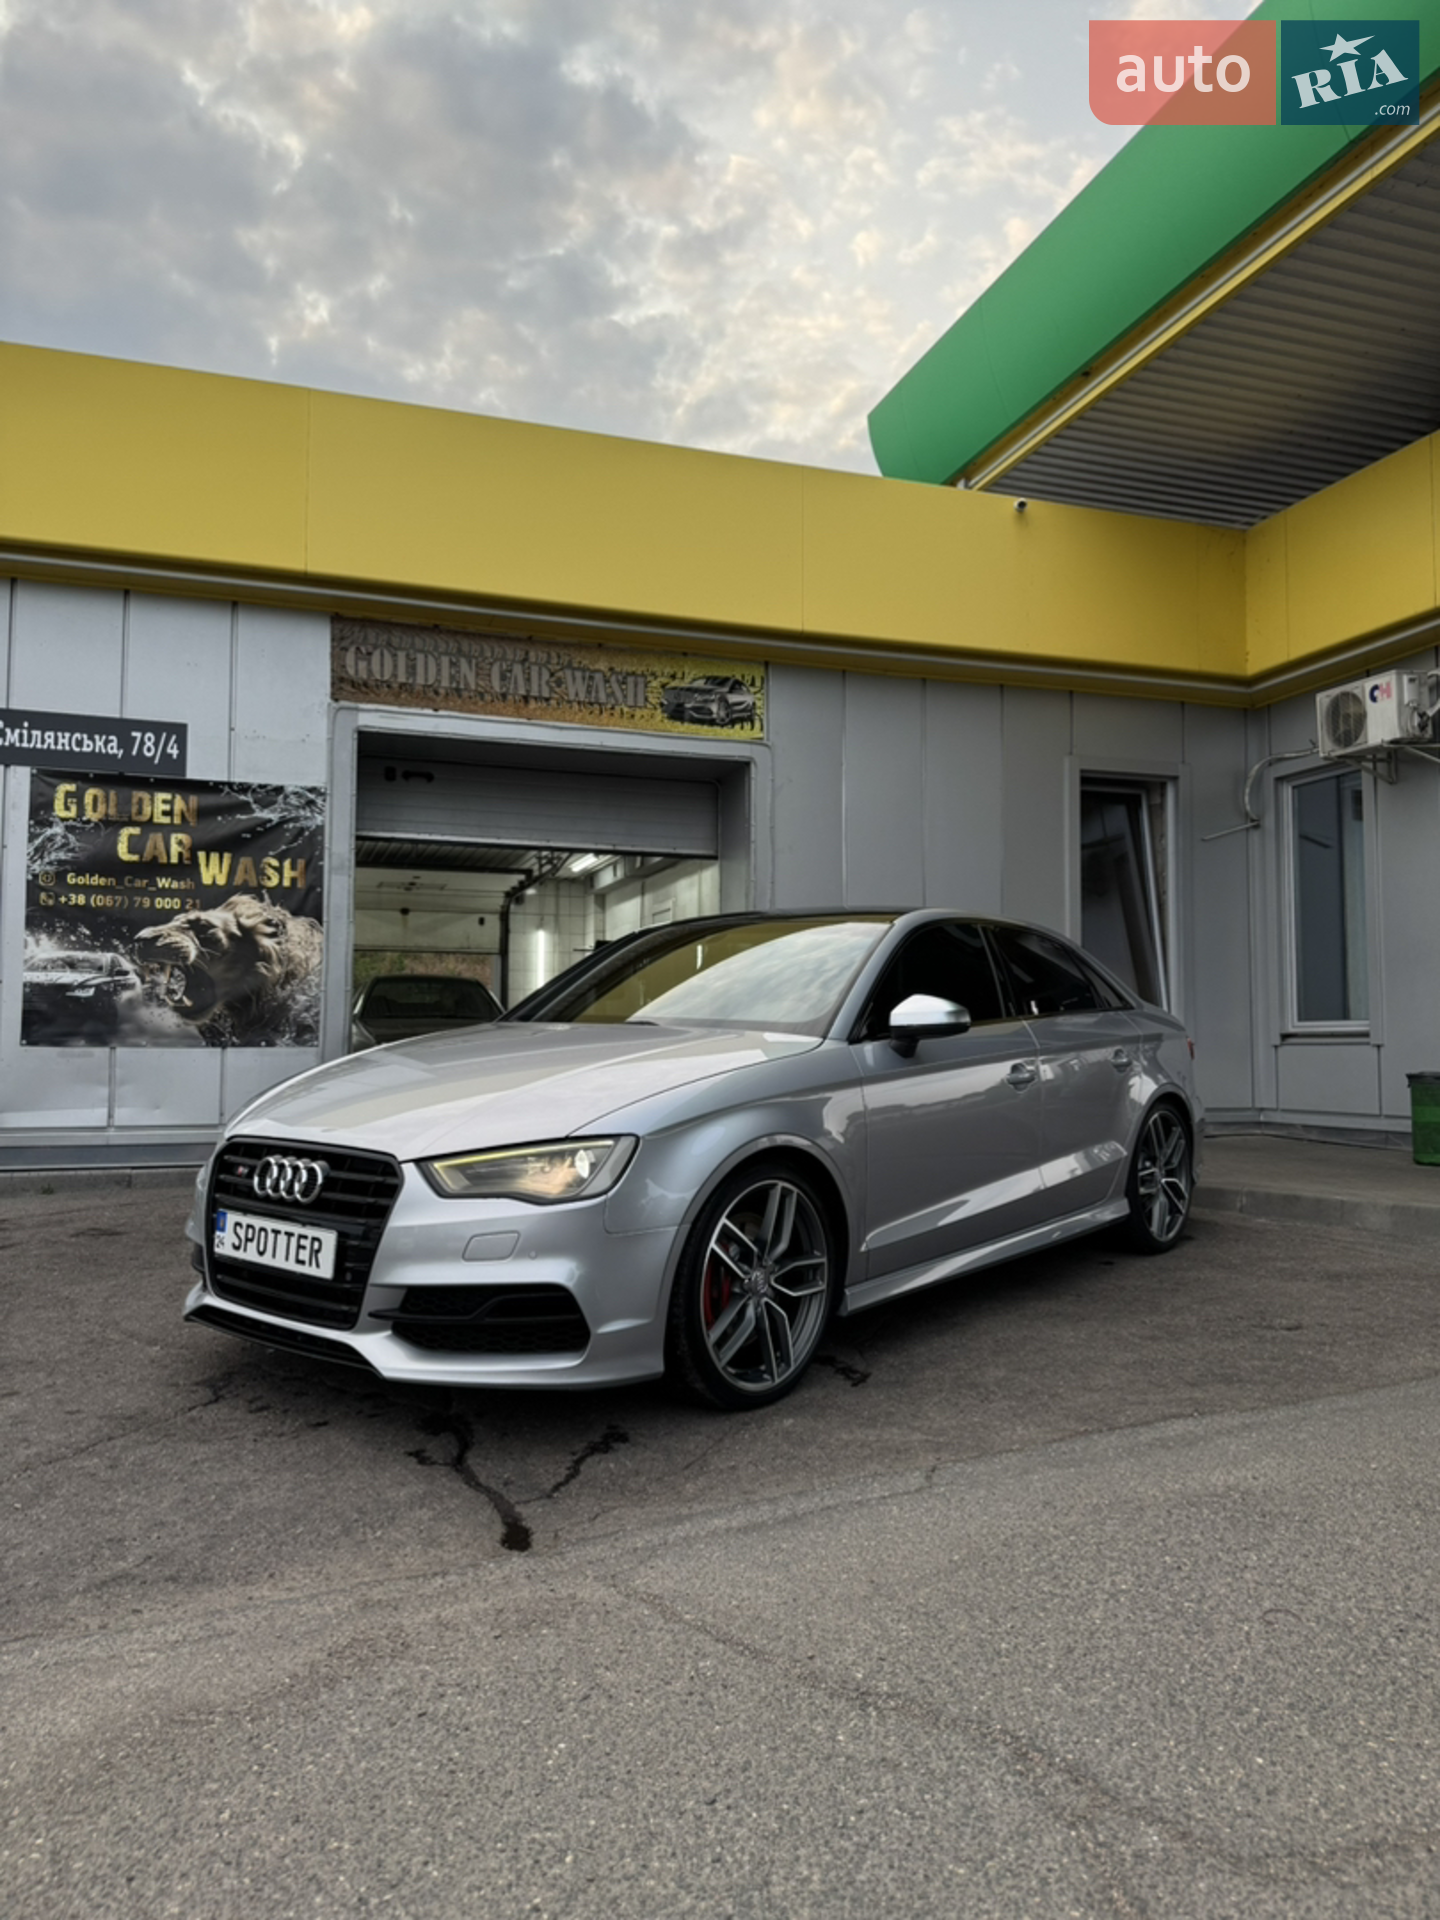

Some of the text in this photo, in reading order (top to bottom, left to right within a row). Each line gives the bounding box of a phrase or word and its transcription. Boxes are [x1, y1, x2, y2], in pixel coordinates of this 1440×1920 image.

[344, 644, 646, 708] GOLDEN CAR WASH
[130, 731, 180, 765] 78/4
[58, 893, 86, 907] +38
[133, 896, 151, 908] 79
[155, 897, 181, 910] 000
[231, 1221, 323, 1269] SPOTTER
